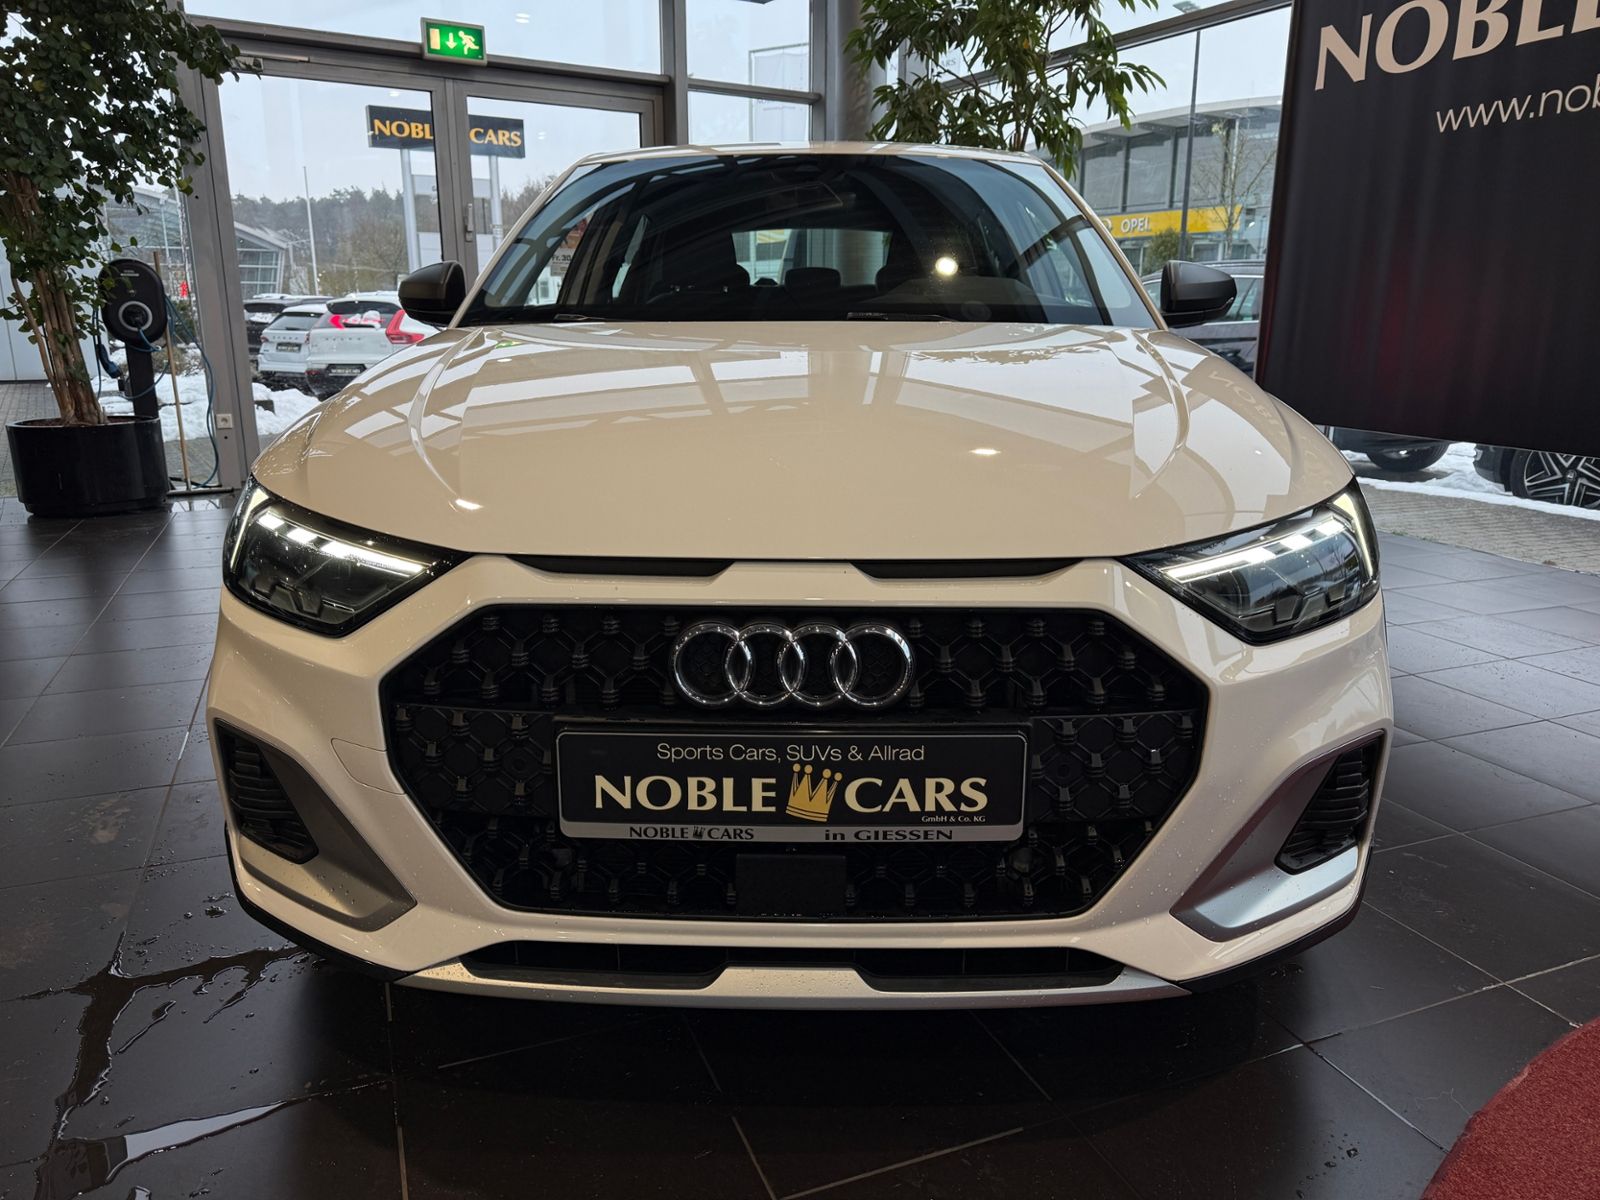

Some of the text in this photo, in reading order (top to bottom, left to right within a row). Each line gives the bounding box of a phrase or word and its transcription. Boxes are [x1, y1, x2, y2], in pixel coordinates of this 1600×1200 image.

[1315, 0, 1600, 90] NOBL
[373, 119, 522, 147] NOBL CARS
[1120, 217, 1150, 233] OPEL
[657, 743, 925, 763] Sports Cars, SUVs & Allrad
[594, 775, 988, 813] NOBLE CARS
[921, 815, 986, 823] GmbH & Co. KG
[629, 826, 953, 841] NOBLE CARS in GIESSEN
